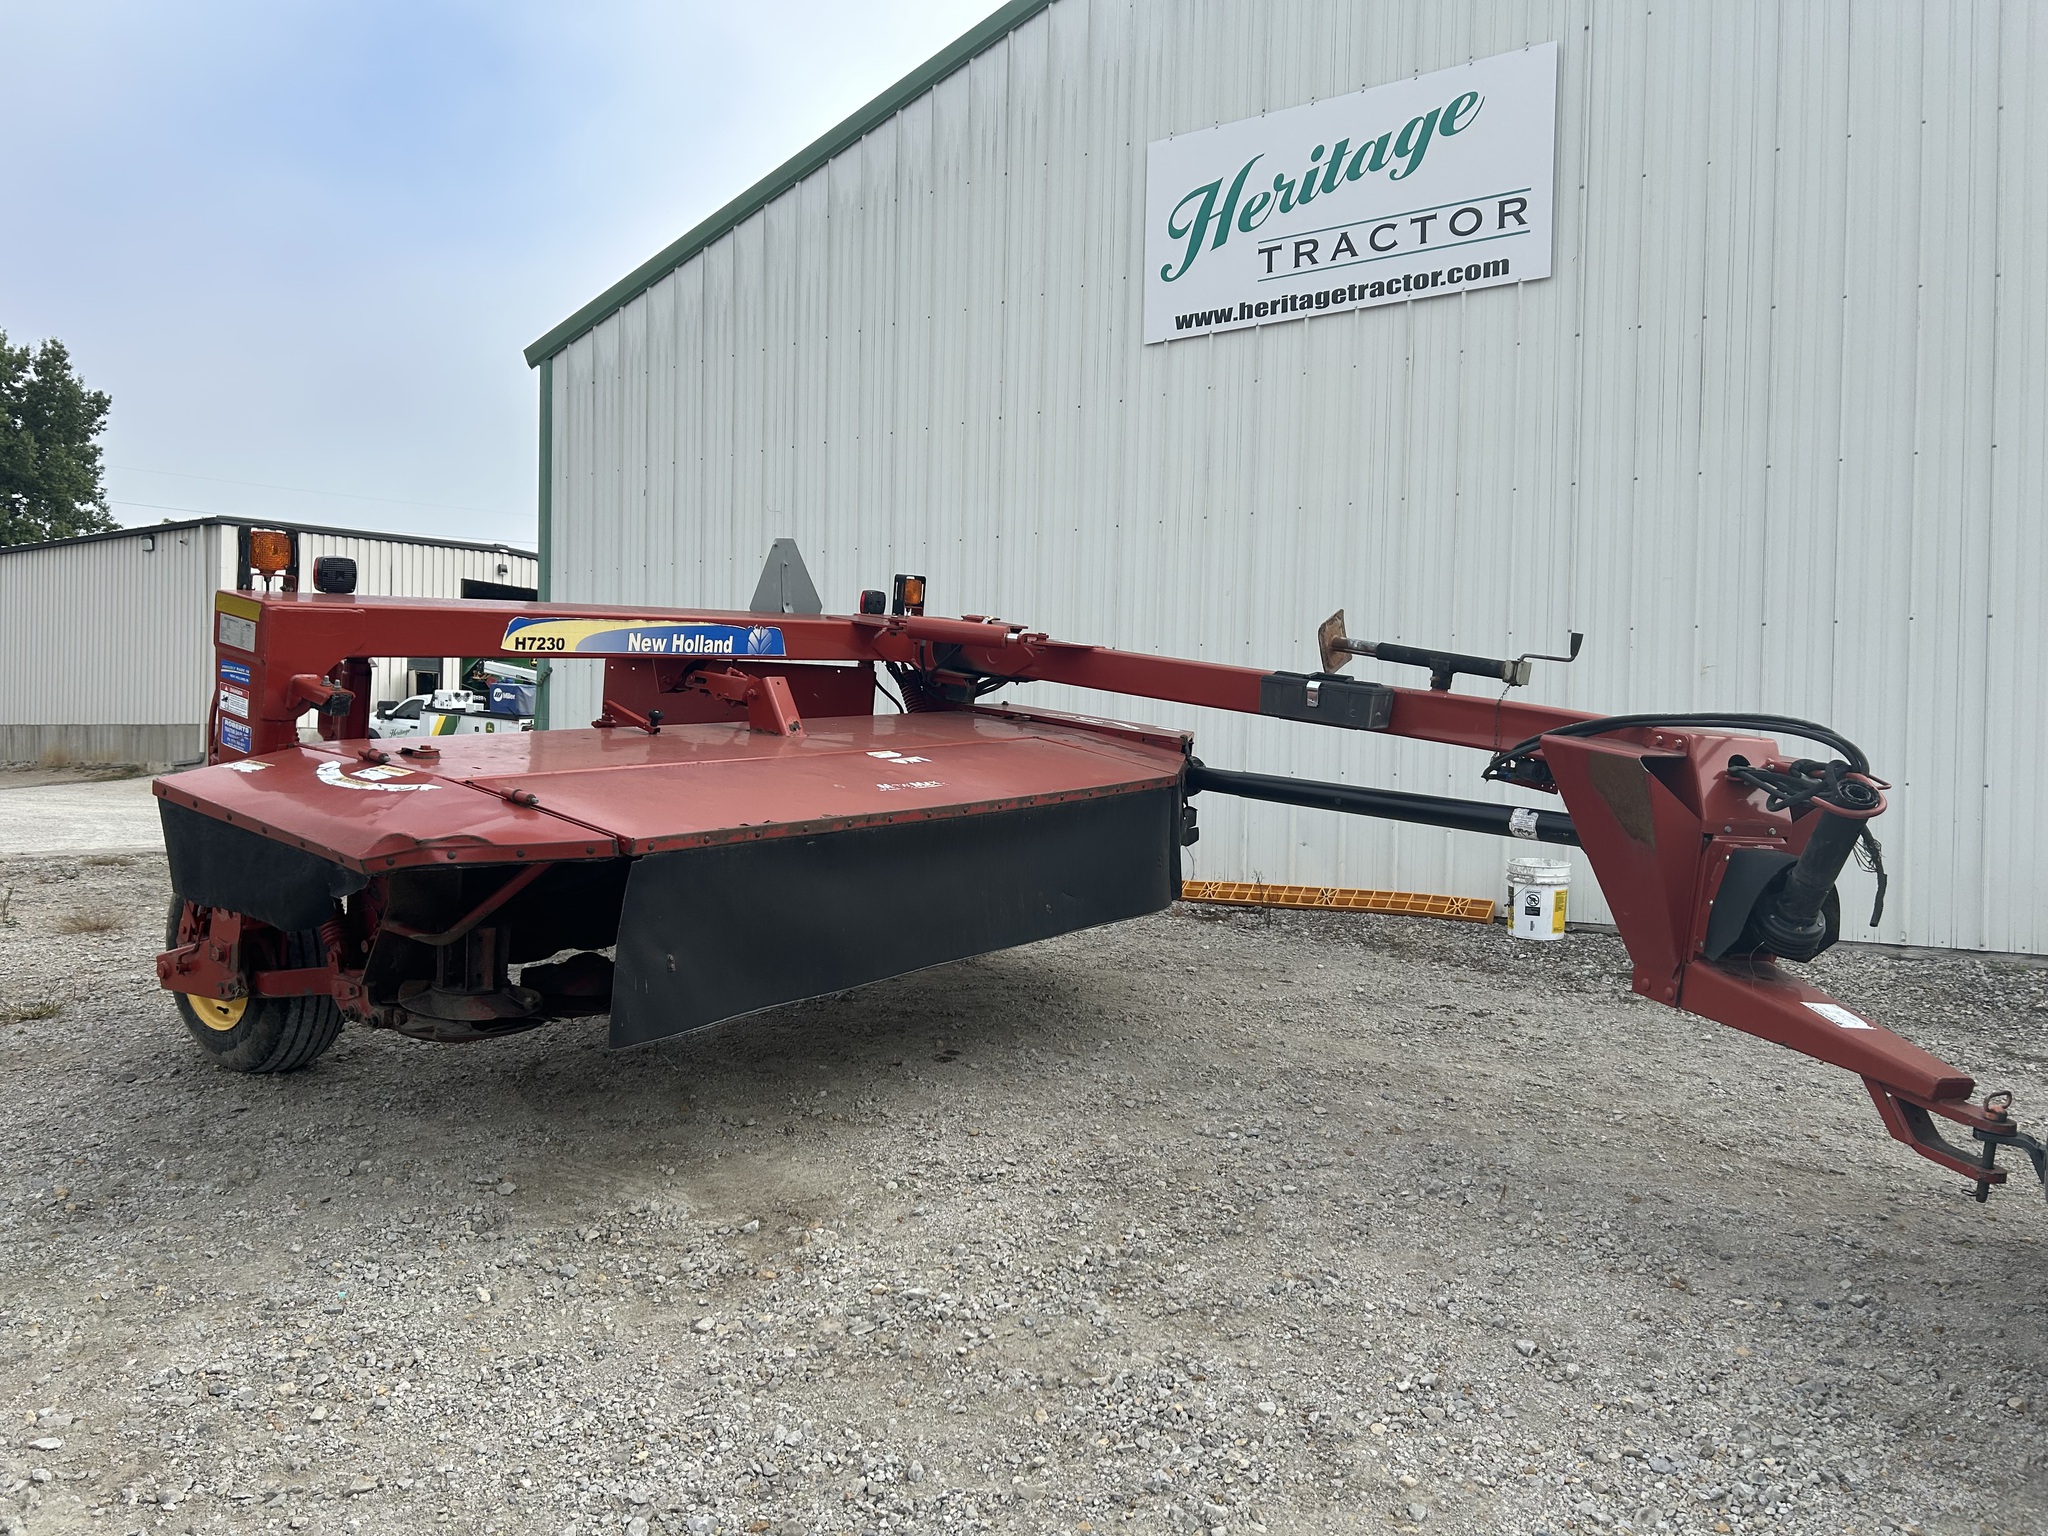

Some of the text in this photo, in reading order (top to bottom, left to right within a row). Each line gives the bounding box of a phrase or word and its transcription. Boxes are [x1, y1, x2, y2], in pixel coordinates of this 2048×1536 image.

[1160, 91, 1486, 282] Heritage
[1257, 197, 1529, 273] TRACTOR
[1174, 257, 1510, 331] www.heritagetractor.com
[514, 632, 733, 654] H7230 New Holland
[502, 691, 516, 700] Miller
[224, 719, 250, 734] ROBERTS
